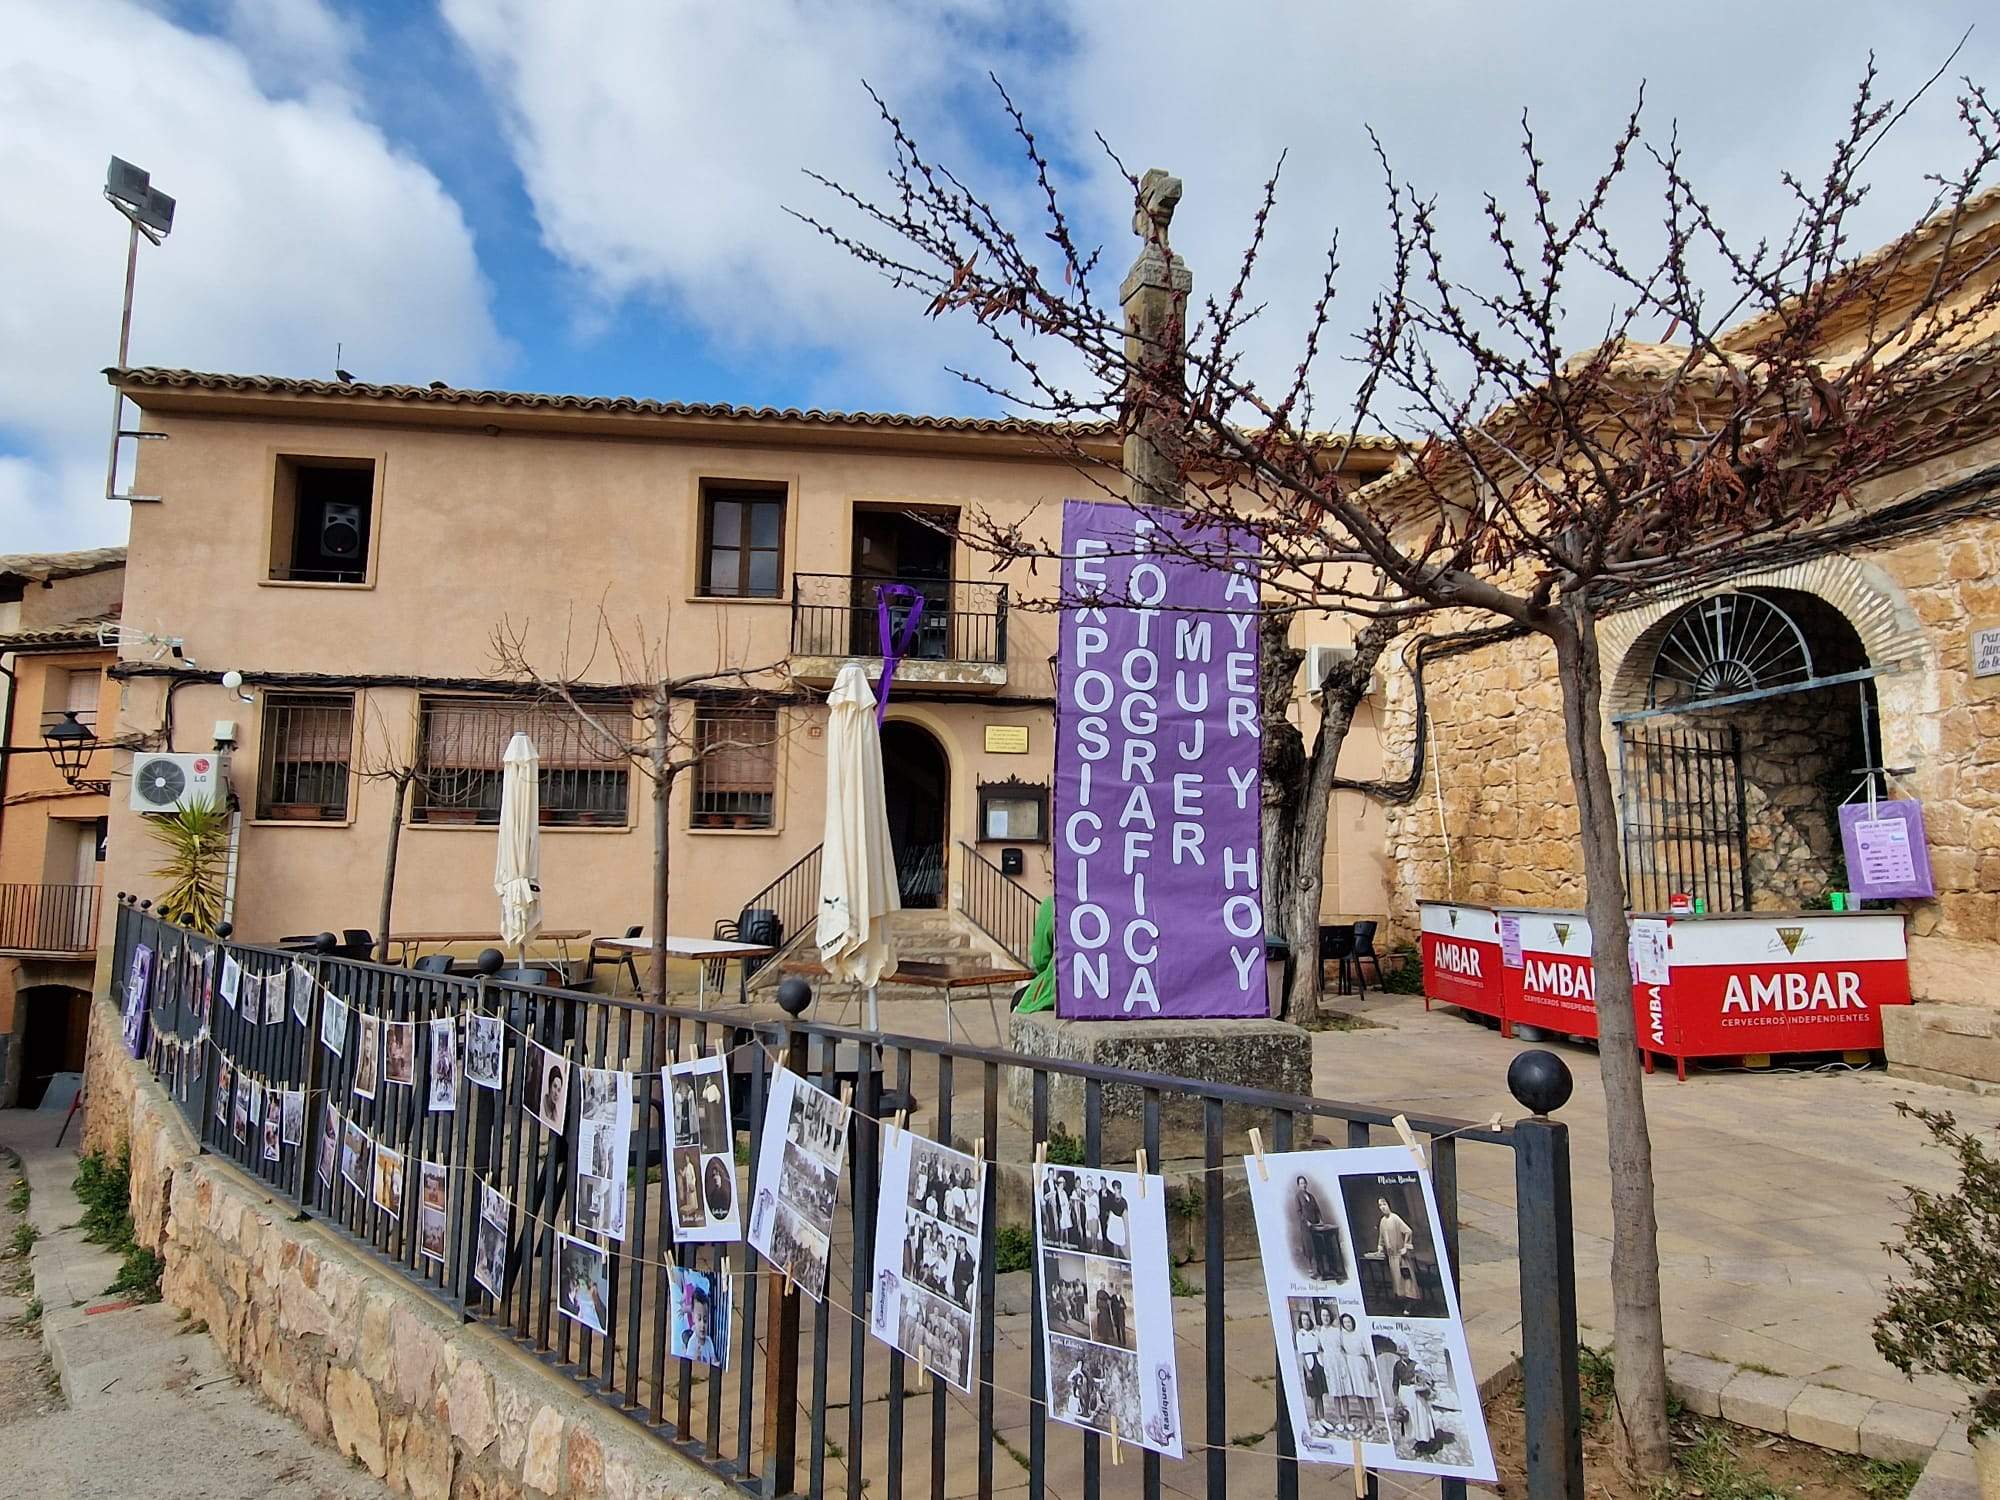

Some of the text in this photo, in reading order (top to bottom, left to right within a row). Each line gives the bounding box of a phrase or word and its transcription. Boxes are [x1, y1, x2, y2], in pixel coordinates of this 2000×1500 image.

[1119, 519, 1168, 1013] FOTOGRAFICA
[1172, 618, 1212, 866] MUJER
[194, 775, 207, 783] LG
[1065, 539, 1114, 1000] EXPOSICION
[1434, 941, 1482, 978] AMBAR
[1648, 986, 1665, 1046] AMBA
[1721, 971, 1869, 1013] AMBAR
[1721, 1013, 1870, 1027] CERVECEROS INDEPENDIENTES
